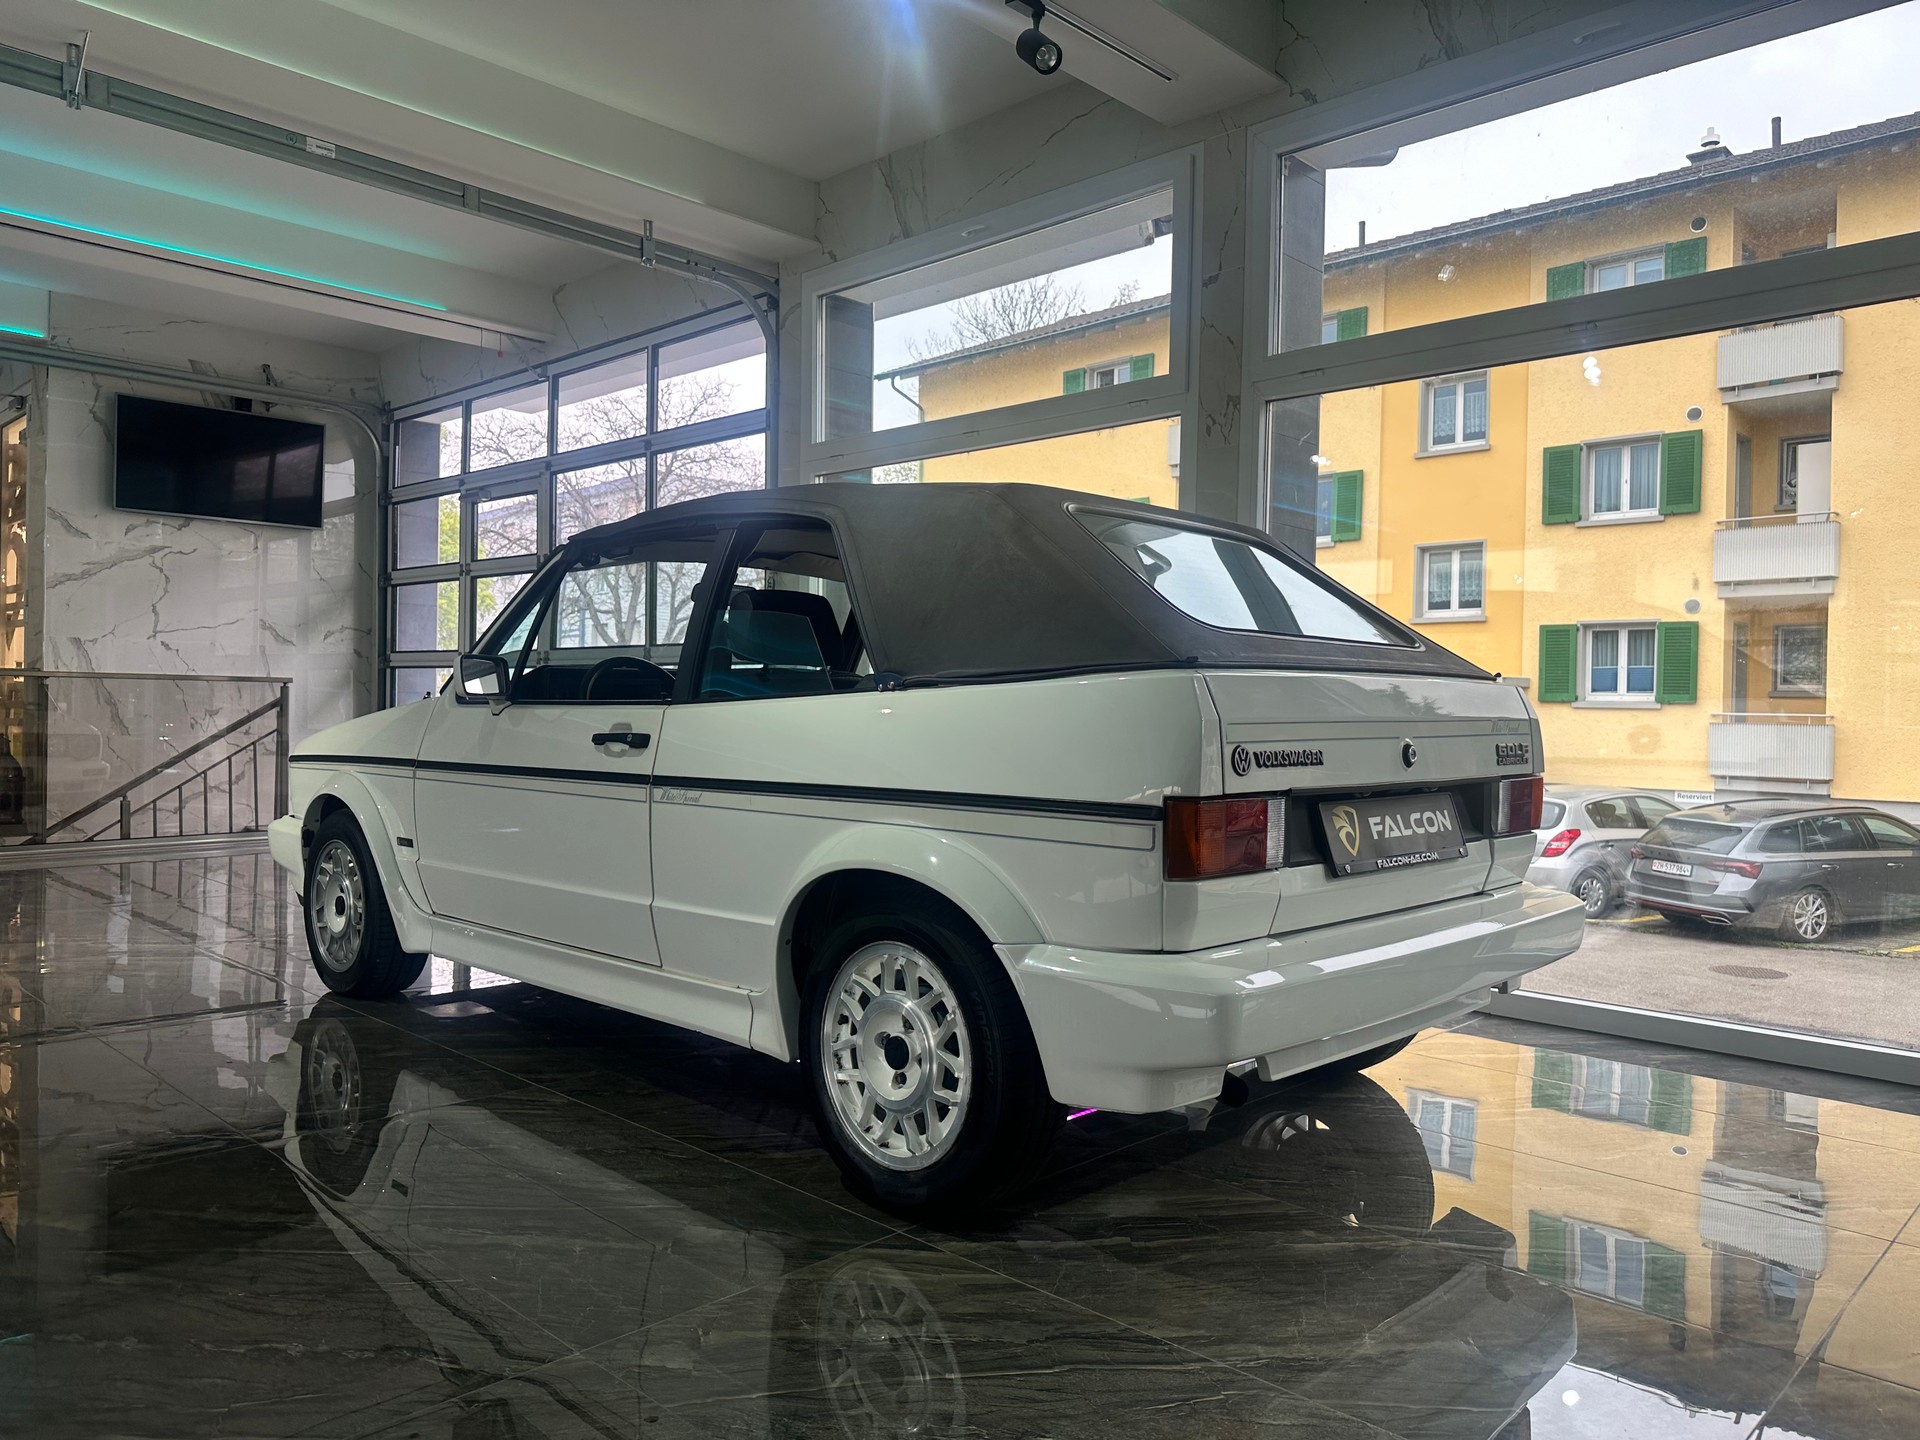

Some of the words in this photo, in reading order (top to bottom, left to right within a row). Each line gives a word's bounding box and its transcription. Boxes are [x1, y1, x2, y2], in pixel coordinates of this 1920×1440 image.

[1253, 749, 1324, 769] VOLKSWAGEN
[1496, 743, 1529, 758] GOLF
[1677, 792, 1713, 801] Reserviert
[1367, 809, 1453, 840] FALCON
[1376, 851, 1440, 869] FALCON-AG.COM
